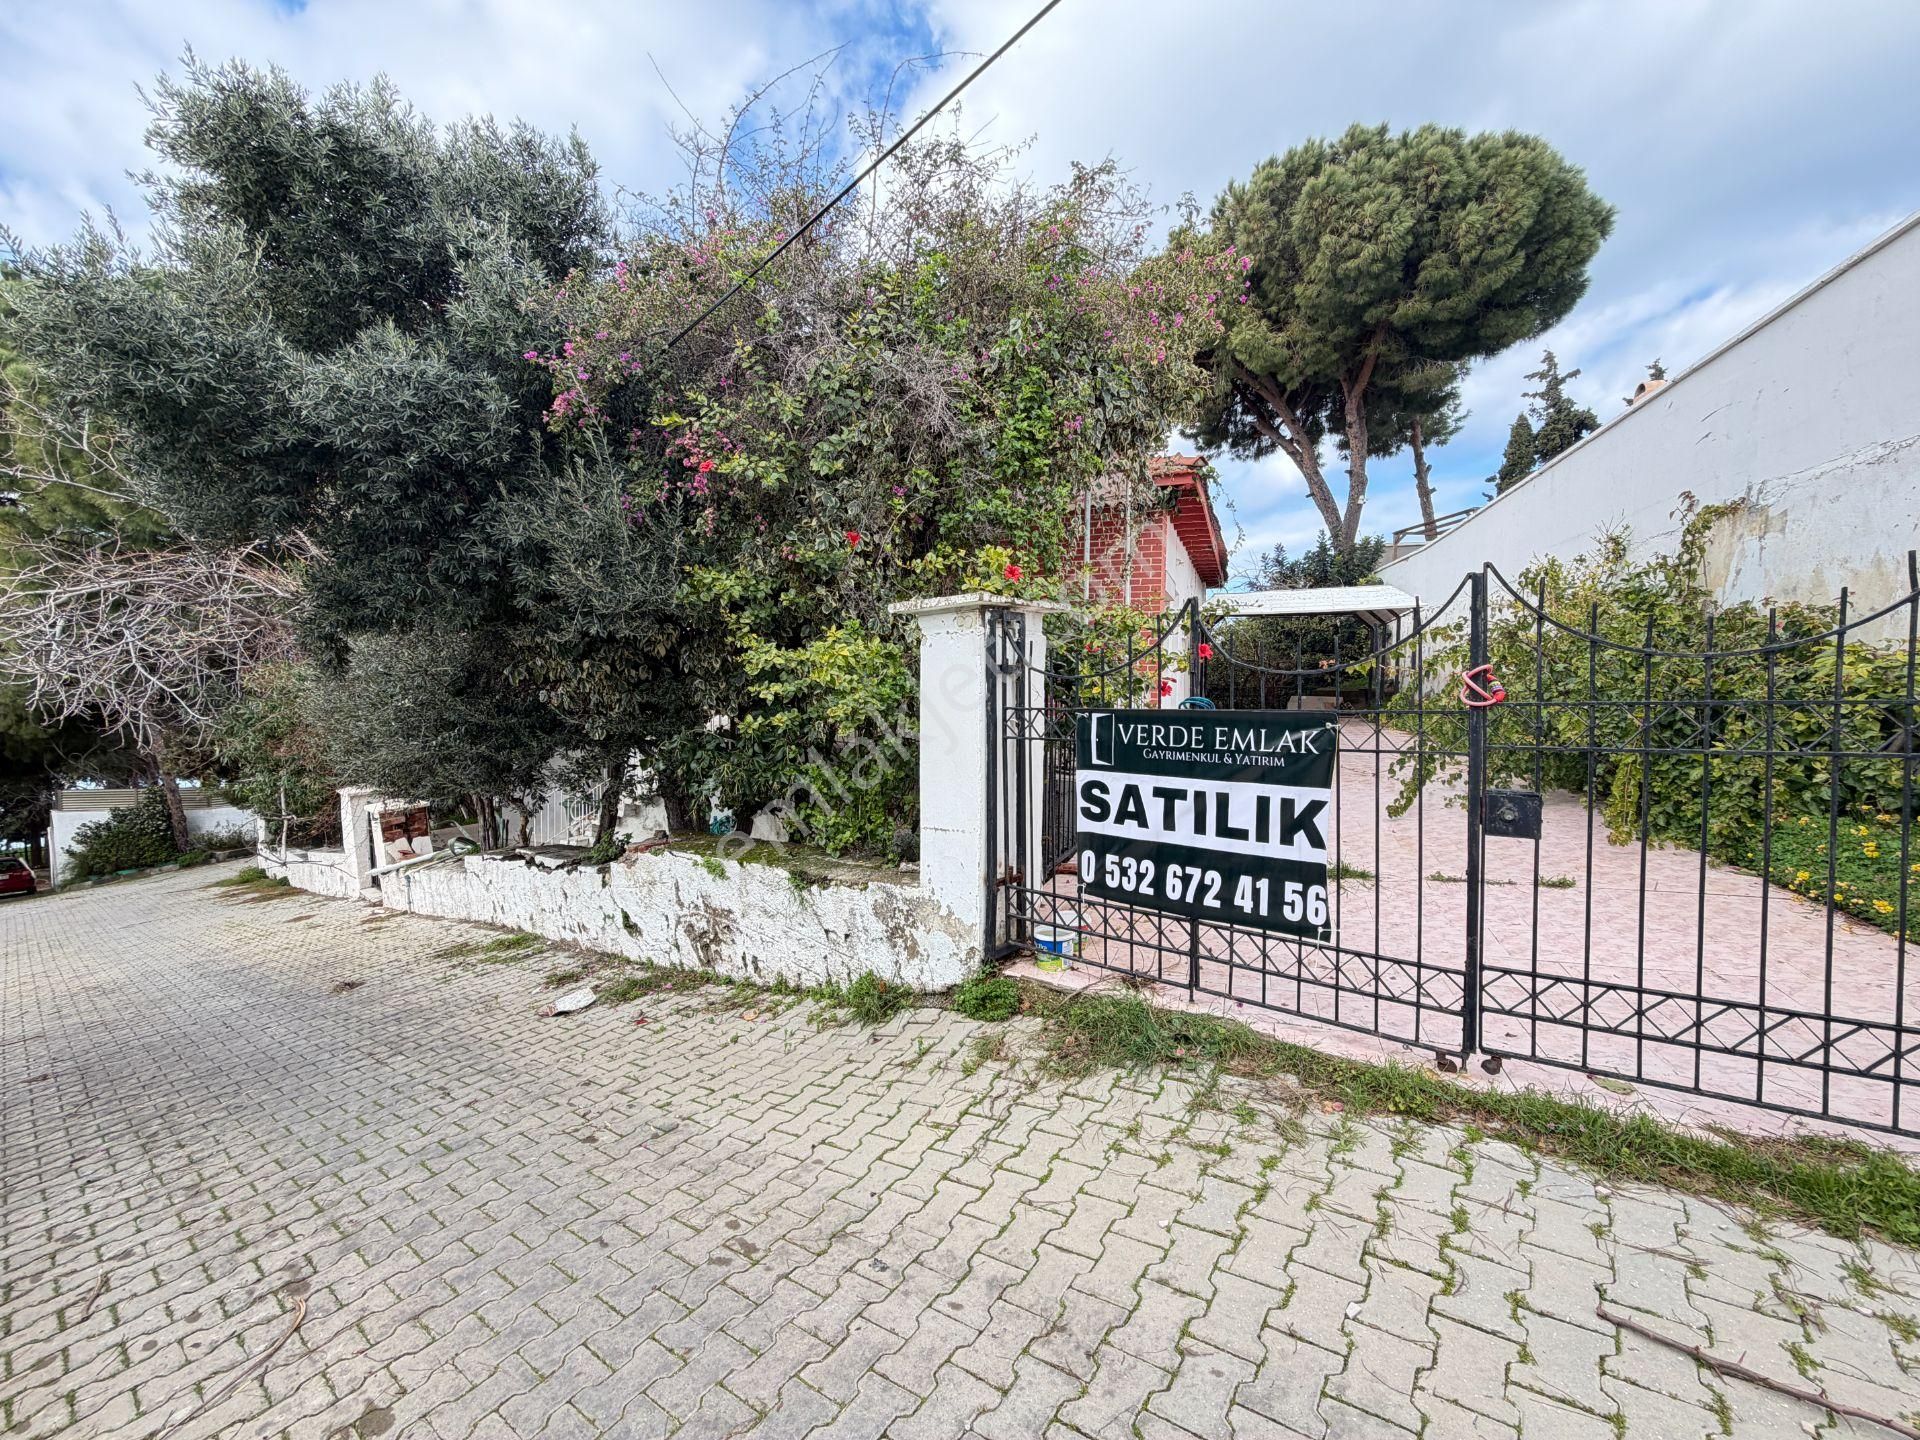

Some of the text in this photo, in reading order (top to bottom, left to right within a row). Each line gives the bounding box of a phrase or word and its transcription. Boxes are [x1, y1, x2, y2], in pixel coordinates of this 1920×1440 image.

[1118, 723, 1320, 755] VERDE EMLAK
[1143, 749, 1285, 768] GAYRIMENKUL & YATIRIM
[1080, 780, 1329, 850] SATILIK
[1081, 850, 1327, 926] 0 532 672 41 56
